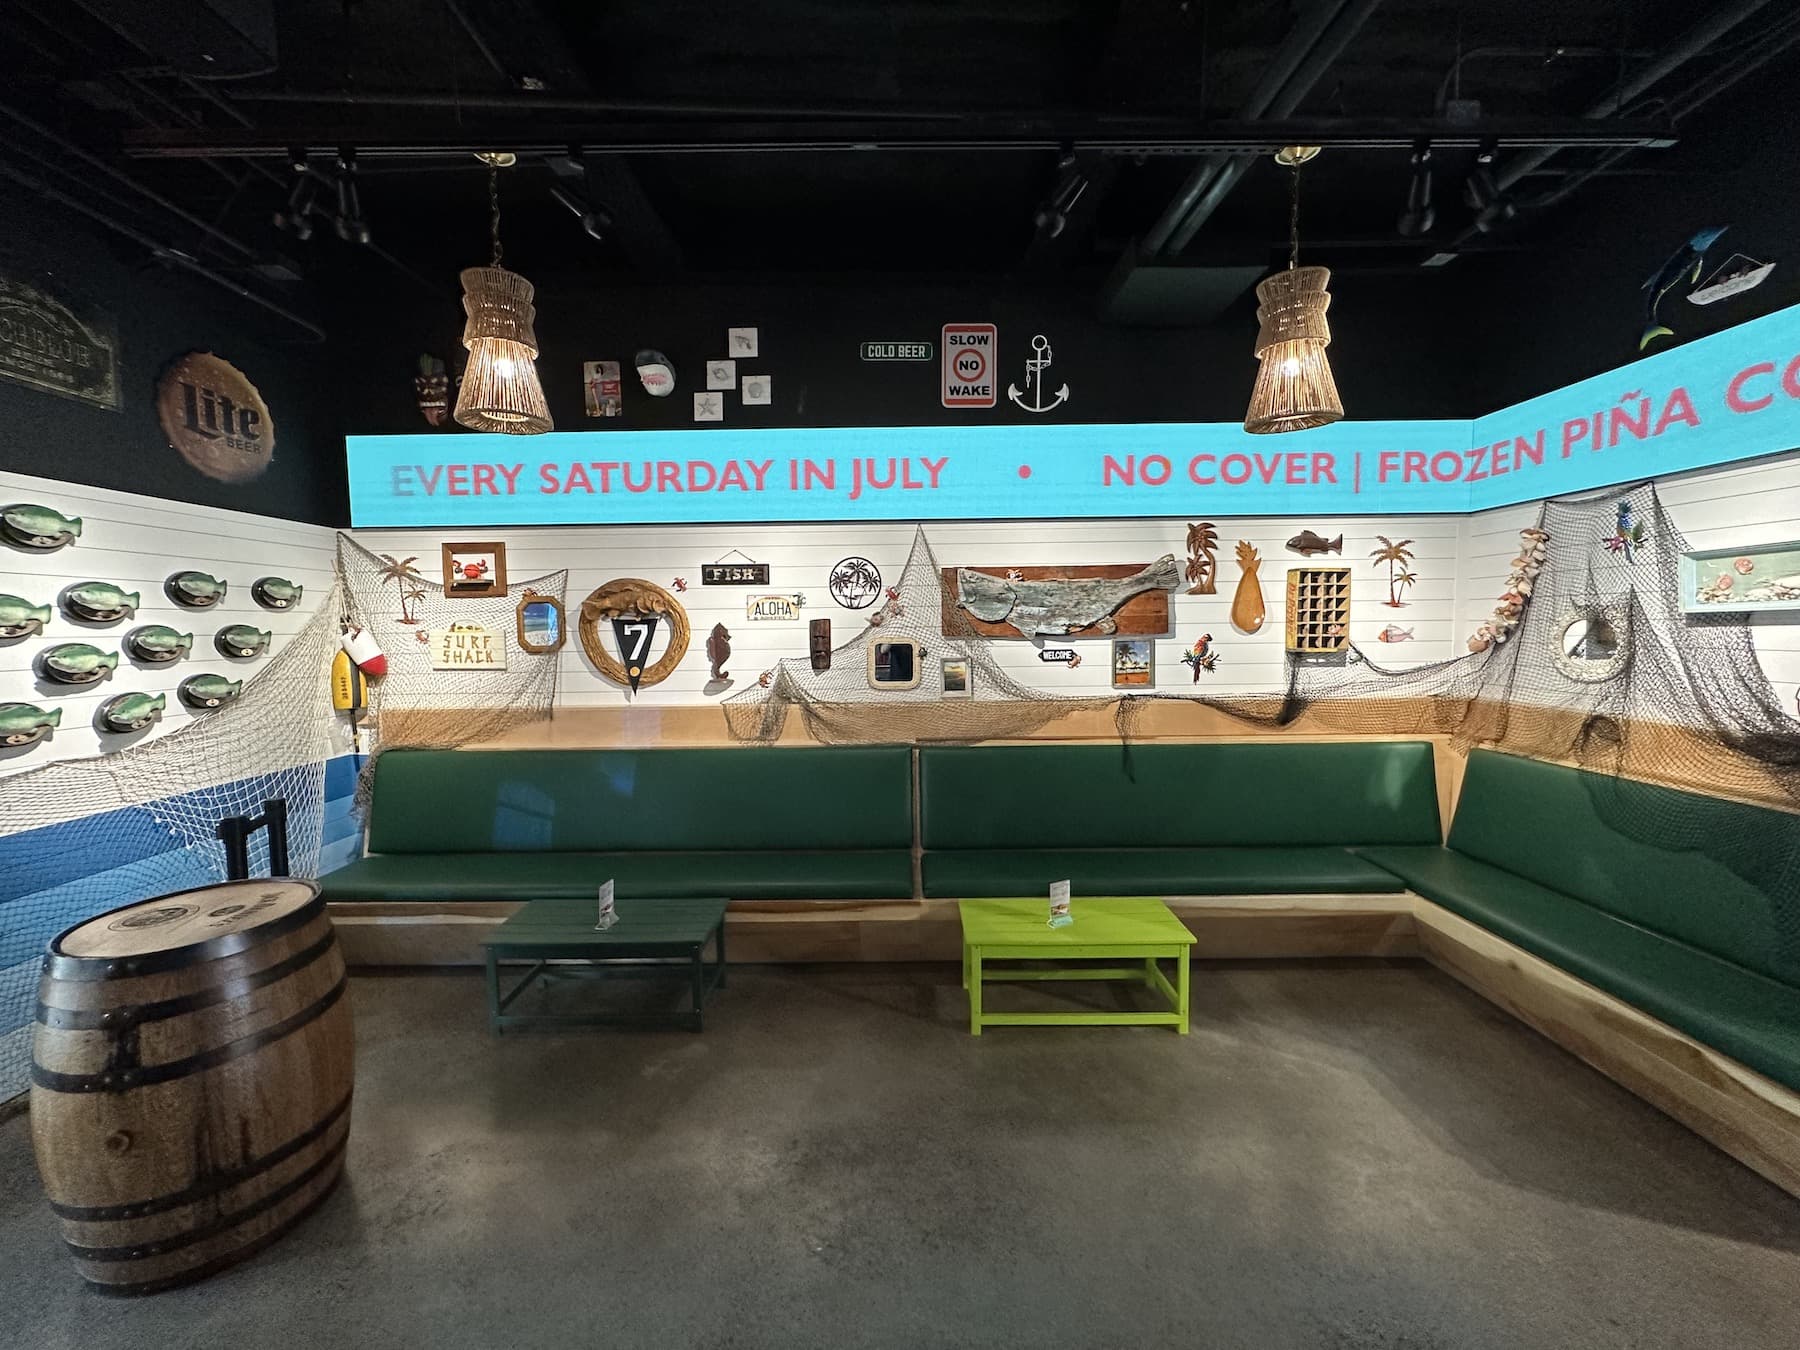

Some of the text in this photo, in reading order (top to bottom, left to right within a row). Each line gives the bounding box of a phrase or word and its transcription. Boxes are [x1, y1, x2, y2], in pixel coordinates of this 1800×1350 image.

[949, 335, 989, 346] SLOW
[868, 344, 926, 358] COLD BEER
[959, 360, 980, 371] NO
[949, 385, 990, 396] WAKE
[179, 381, 261, 441] Lite
[226, 438, 262, 455] BEER
[391, 463, 524, 497] EVERY
[539, 459, 775, 495] SATURDAY
[789, 458, 835, 491] IN
[848, 456, 949, 501] JULY
[1103, 454, 1172, 487] NO
[1188, 452, 1338, 486] COVER
[1378, 429, 1546, 484] FROZEN
[1561, 388, 1701, 459] PIÑA
[712, 568, 755, 581] FISH
[754, 602, 792, 616] ALOHA
[443, 635, 492, 649] SURF
[624, 624, 649, 660] 7
[442, 650, 494, 664] SHACK
[1042, 650, 1073, 660] WELCOME
